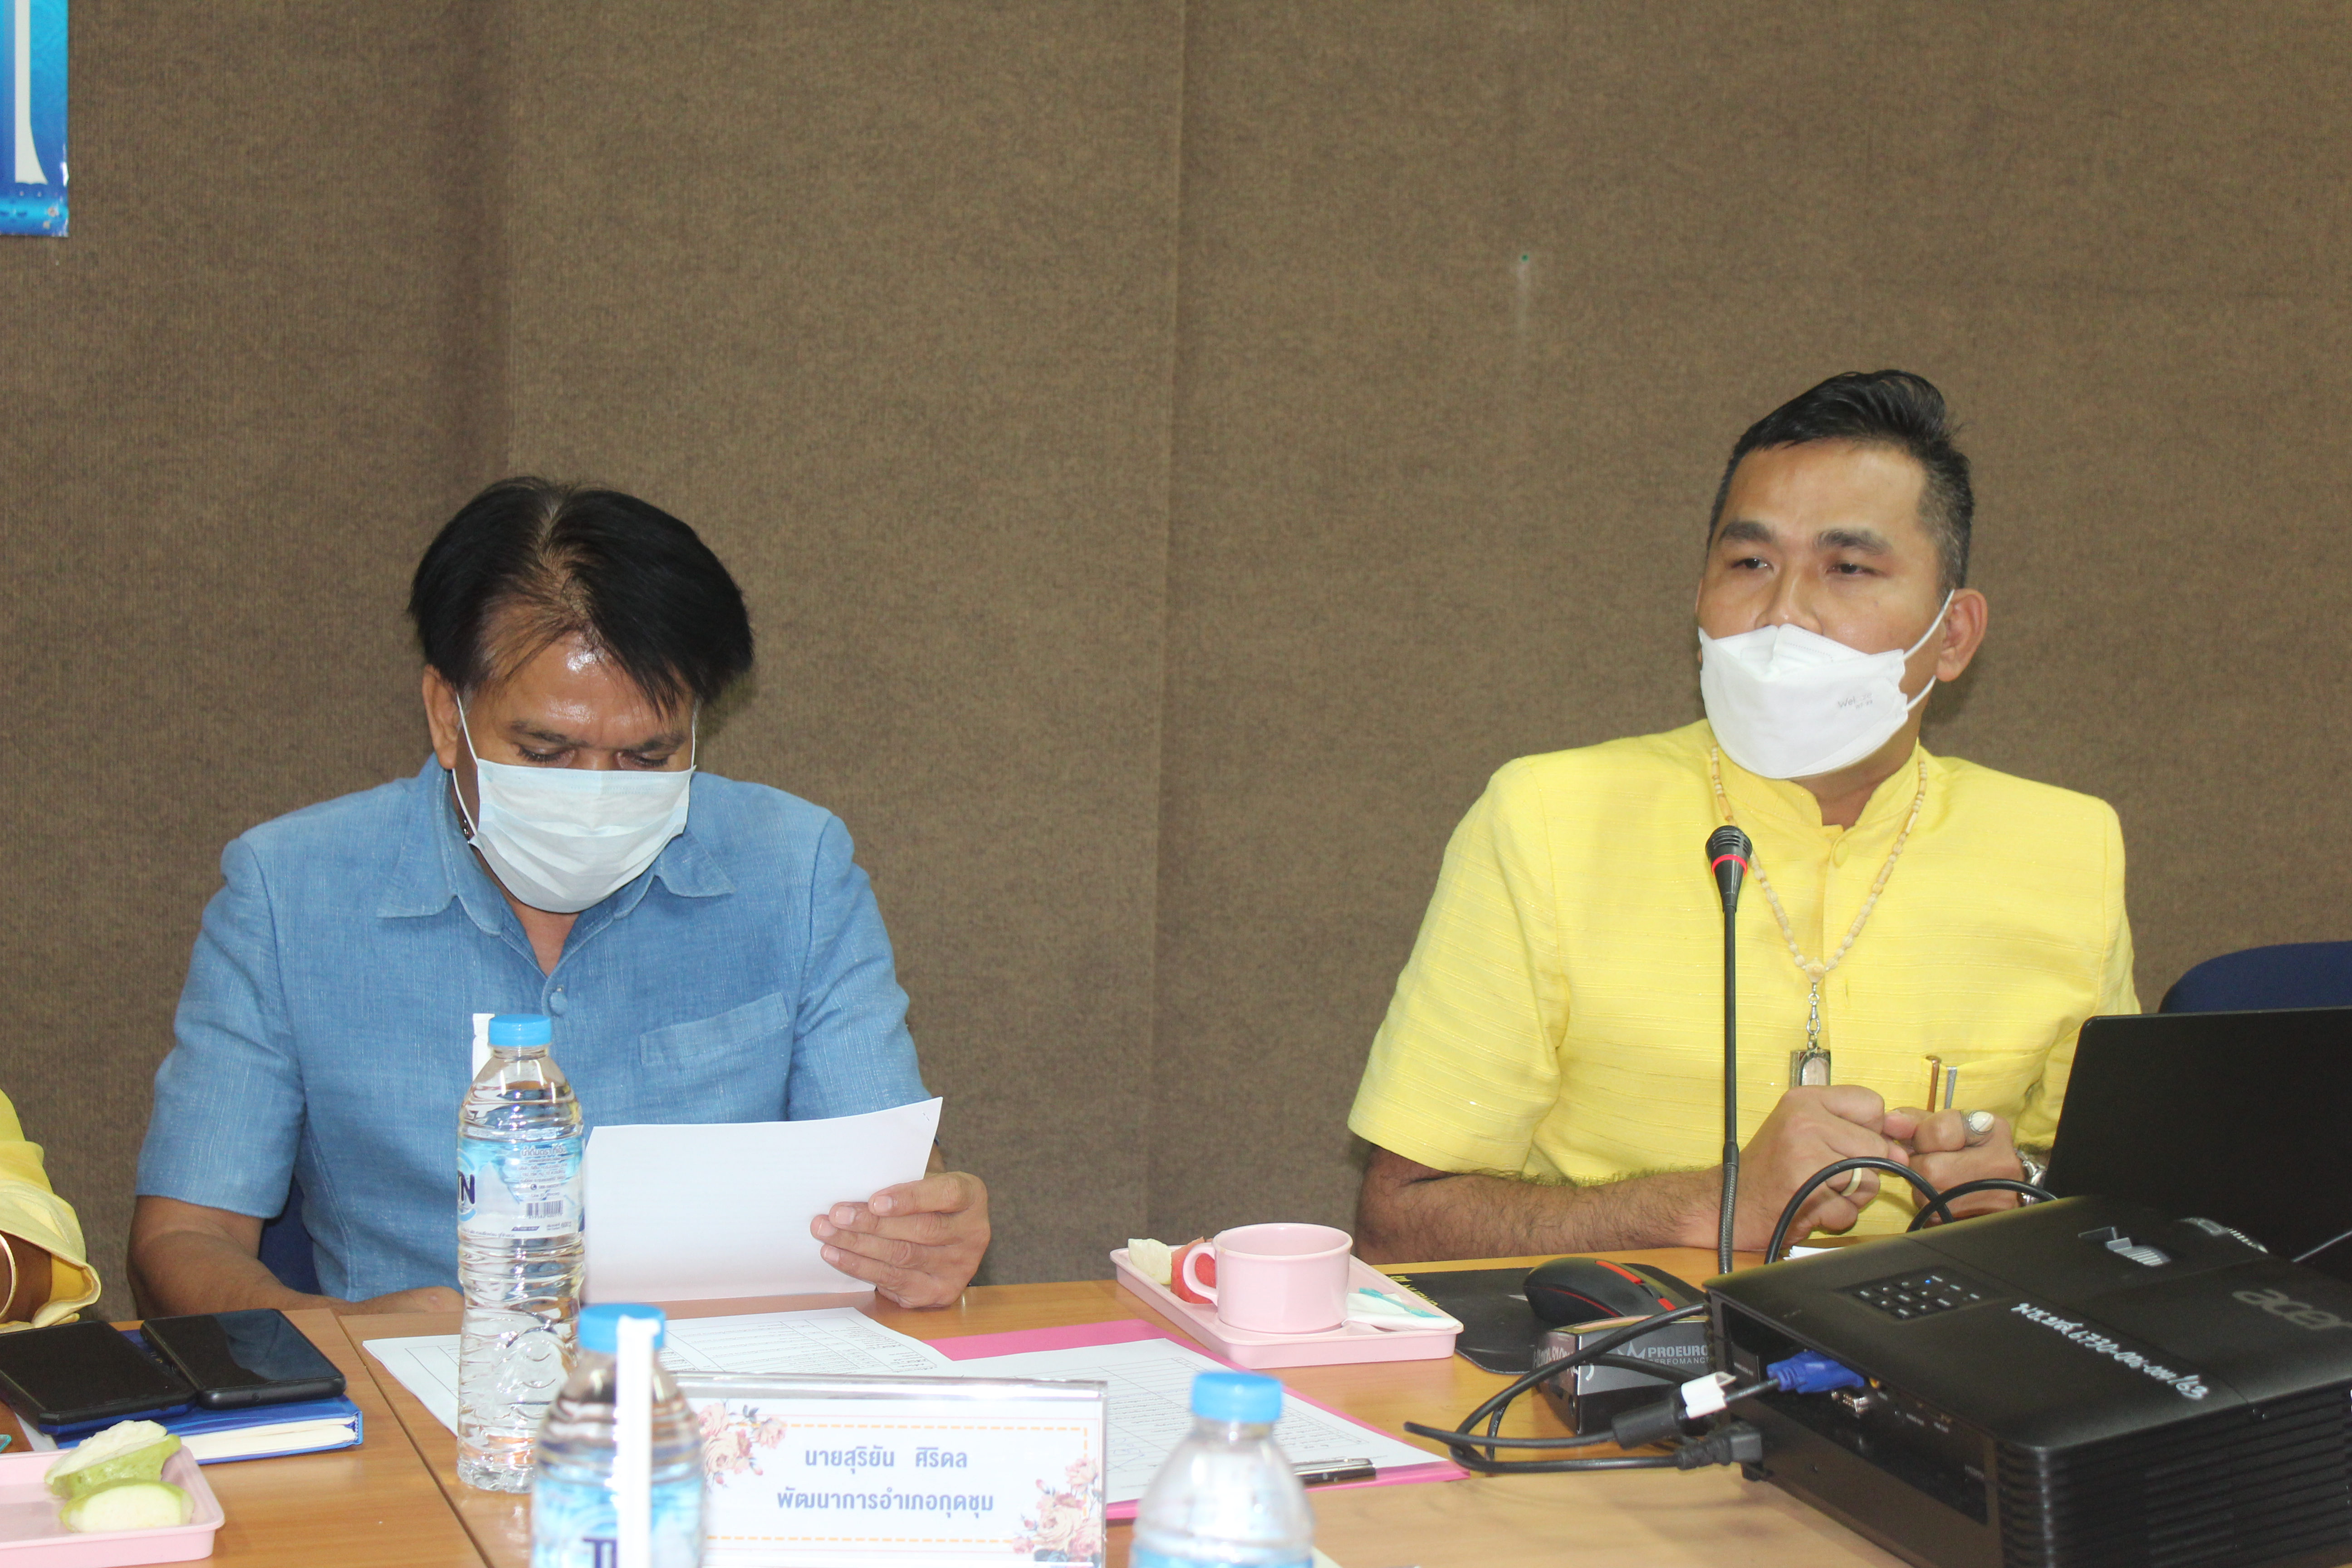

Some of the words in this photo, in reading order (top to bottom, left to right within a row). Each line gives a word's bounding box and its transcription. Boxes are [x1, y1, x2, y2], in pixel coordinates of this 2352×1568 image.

[1647, 1345, 1708, 1357] PROEURO
[805, 1445, 895, 1475] นายสุริยัน
[915, 1447, 967, 1468] ศิริดล
[777, 1486, 994, 1519] พัฒนาการอำเภอกุดชุม
